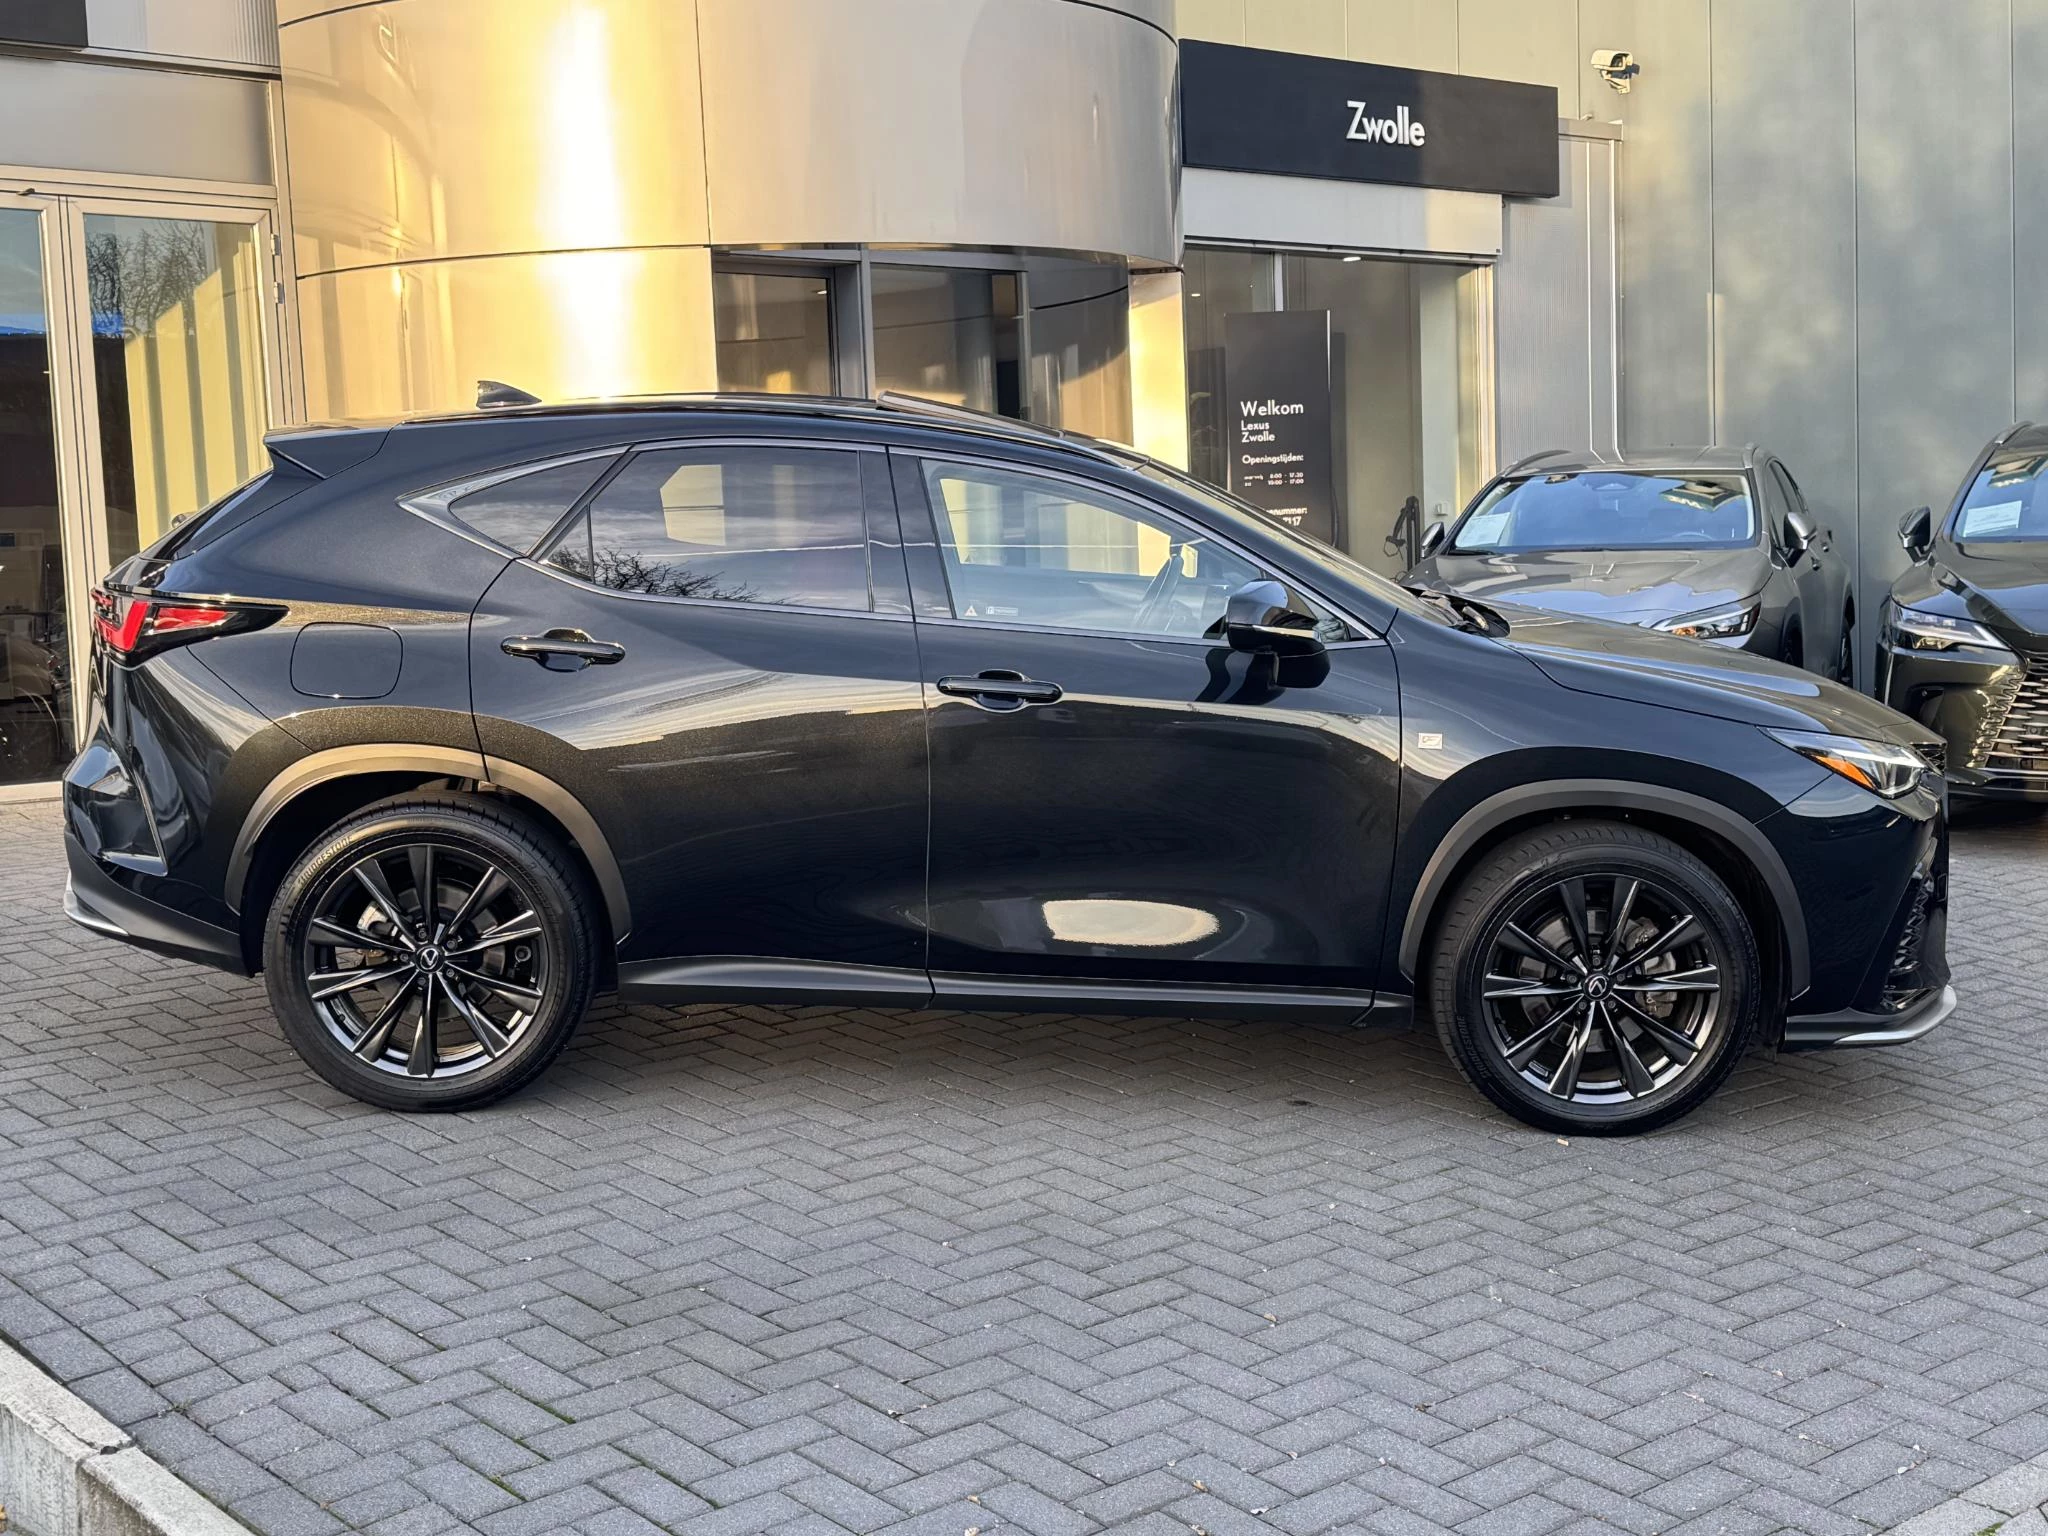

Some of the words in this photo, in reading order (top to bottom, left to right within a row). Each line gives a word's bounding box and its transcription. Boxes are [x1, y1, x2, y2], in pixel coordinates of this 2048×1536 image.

[1346, 99, 1426, 147] Zwolle
[1240, 399, 1304, 417] Welkom
[1241, 419, 1270, 431] Lexus
[1241, 431, 1276, 443] Zwolle
